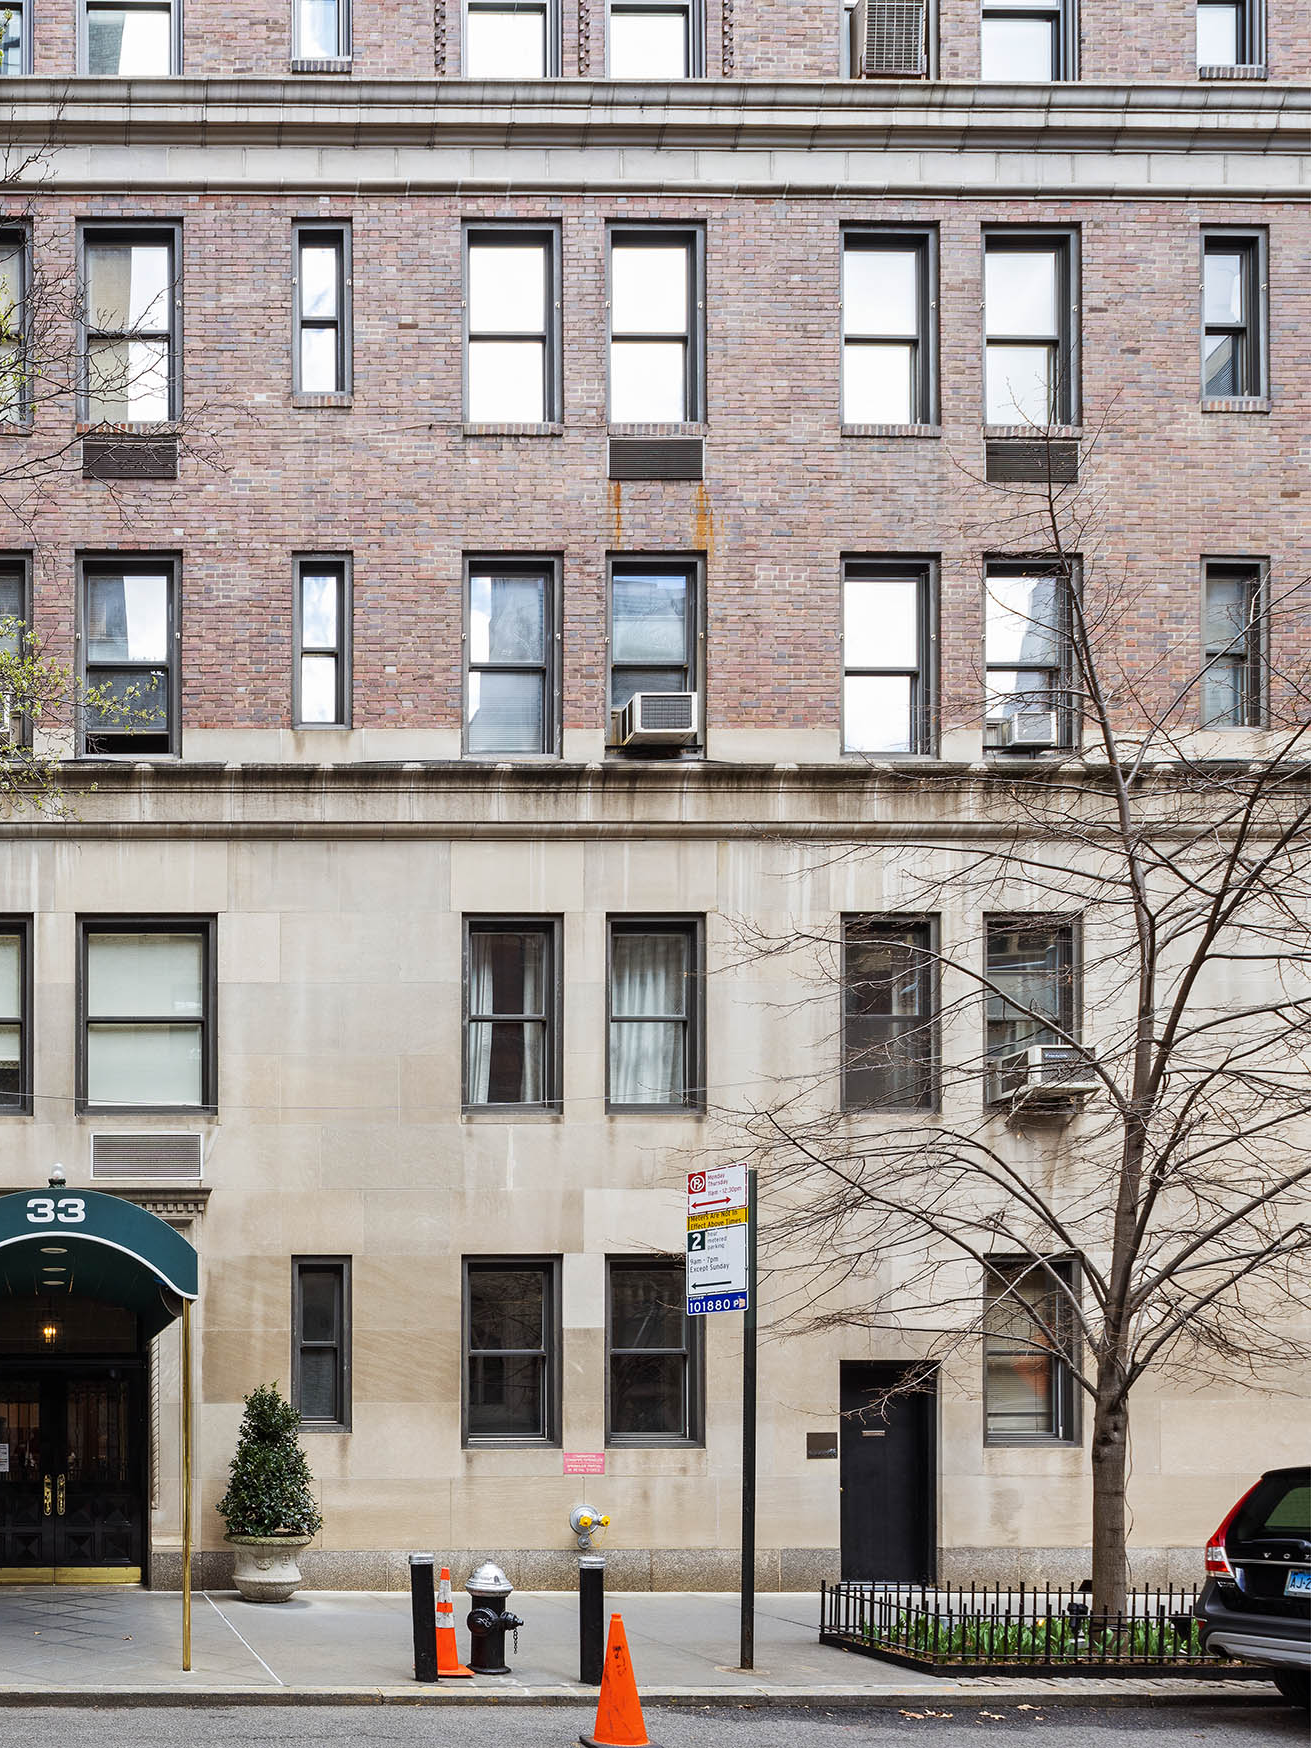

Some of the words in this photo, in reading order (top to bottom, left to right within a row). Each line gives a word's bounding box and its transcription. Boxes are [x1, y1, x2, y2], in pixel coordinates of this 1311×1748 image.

[708, 1179, 728, 1187] Thursday
[26, 1198, 86, 1223] 33
[690, 1214, 709, 1222] Meters
[690, 1222, 707, 1230] Effect
[708, 1220, 724, 1228] Above
[726, 1217, 742, 1225] Times
[692, 1233, 702, 1250] 2
[690, 1264, 709, 1273] Except
[710, 1263, 730, 1271] Sunday
[690, 1298, 731, 1313] 101880
